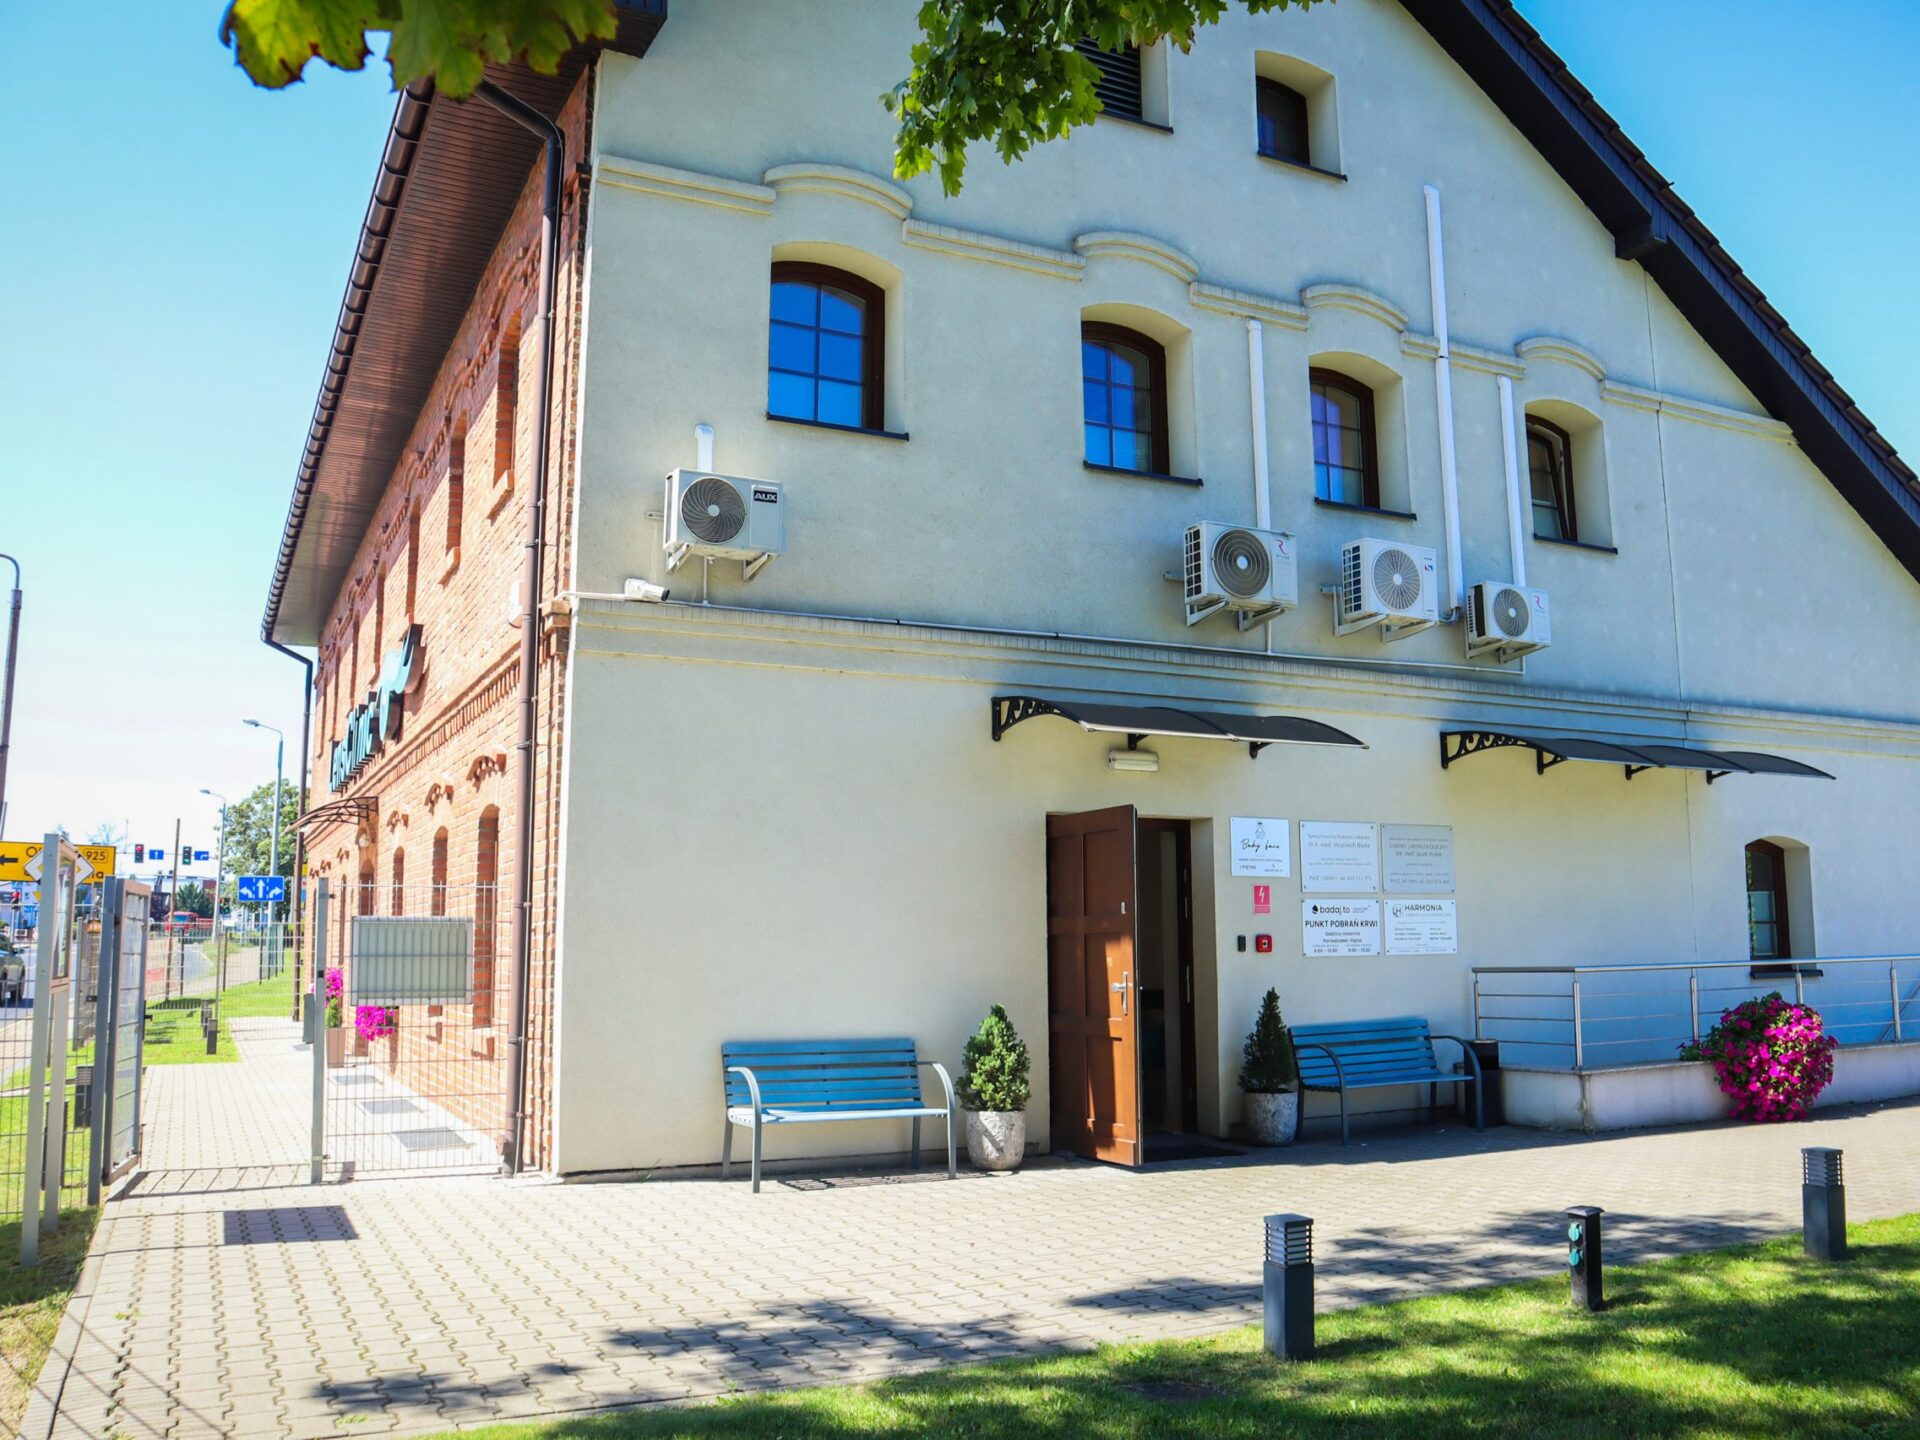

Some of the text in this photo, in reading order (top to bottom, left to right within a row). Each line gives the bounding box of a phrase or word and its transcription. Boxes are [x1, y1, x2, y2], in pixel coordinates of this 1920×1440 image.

[754, 492, 777, 501] AUX
[1240, 838, 1260, 853] Baby
[85, 850, 106, 861] 925
[1319, 905, 1351, 915] badaj.to
[1305, 918, 1378, 928] PUNKT POBRAŃ KRWI
